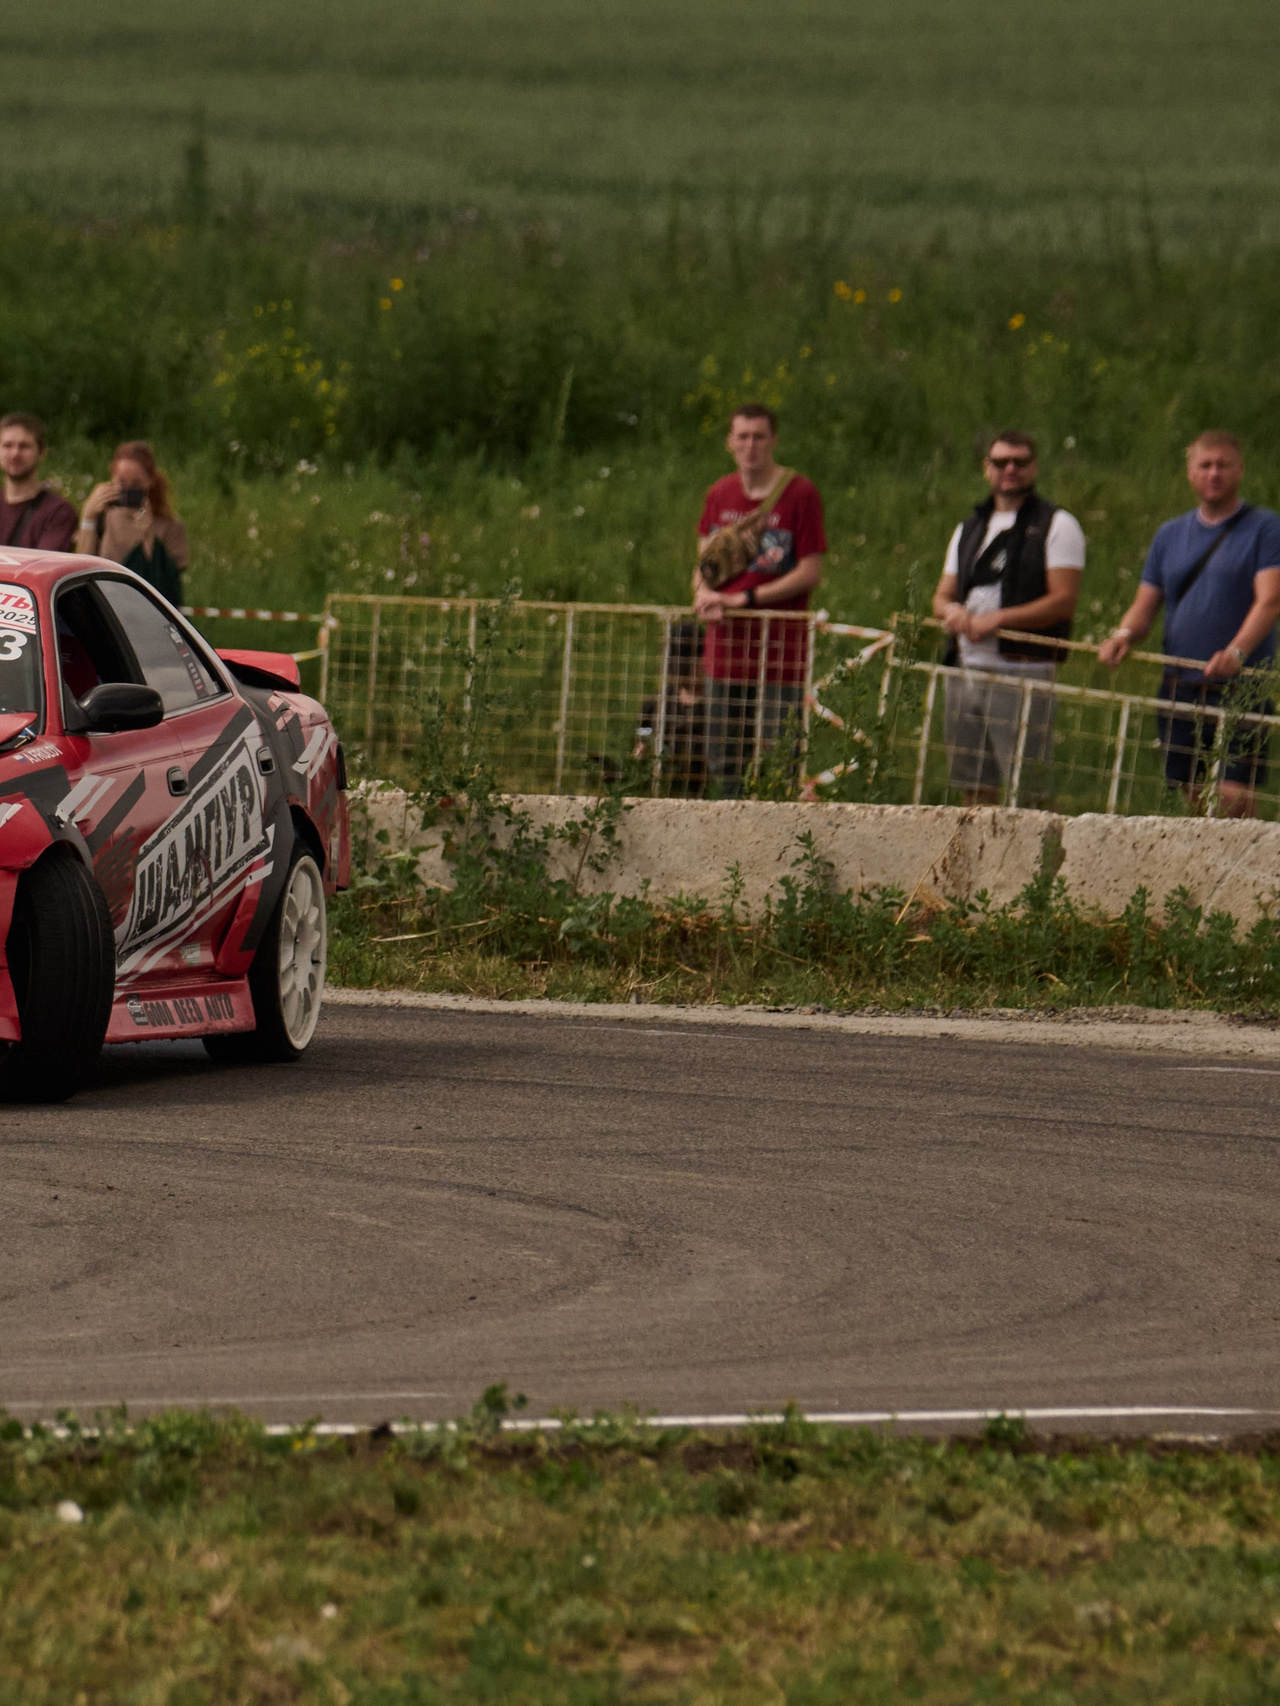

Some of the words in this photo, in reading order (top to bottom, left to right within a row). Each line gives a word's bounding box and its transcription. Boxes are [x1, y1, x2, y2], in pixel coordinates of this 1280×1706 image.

[129, 764, 256, 942] ШАМПУР
[143, 1000, 176, 1028] GOOD
[204, 993, 235, 1021] AUTO
